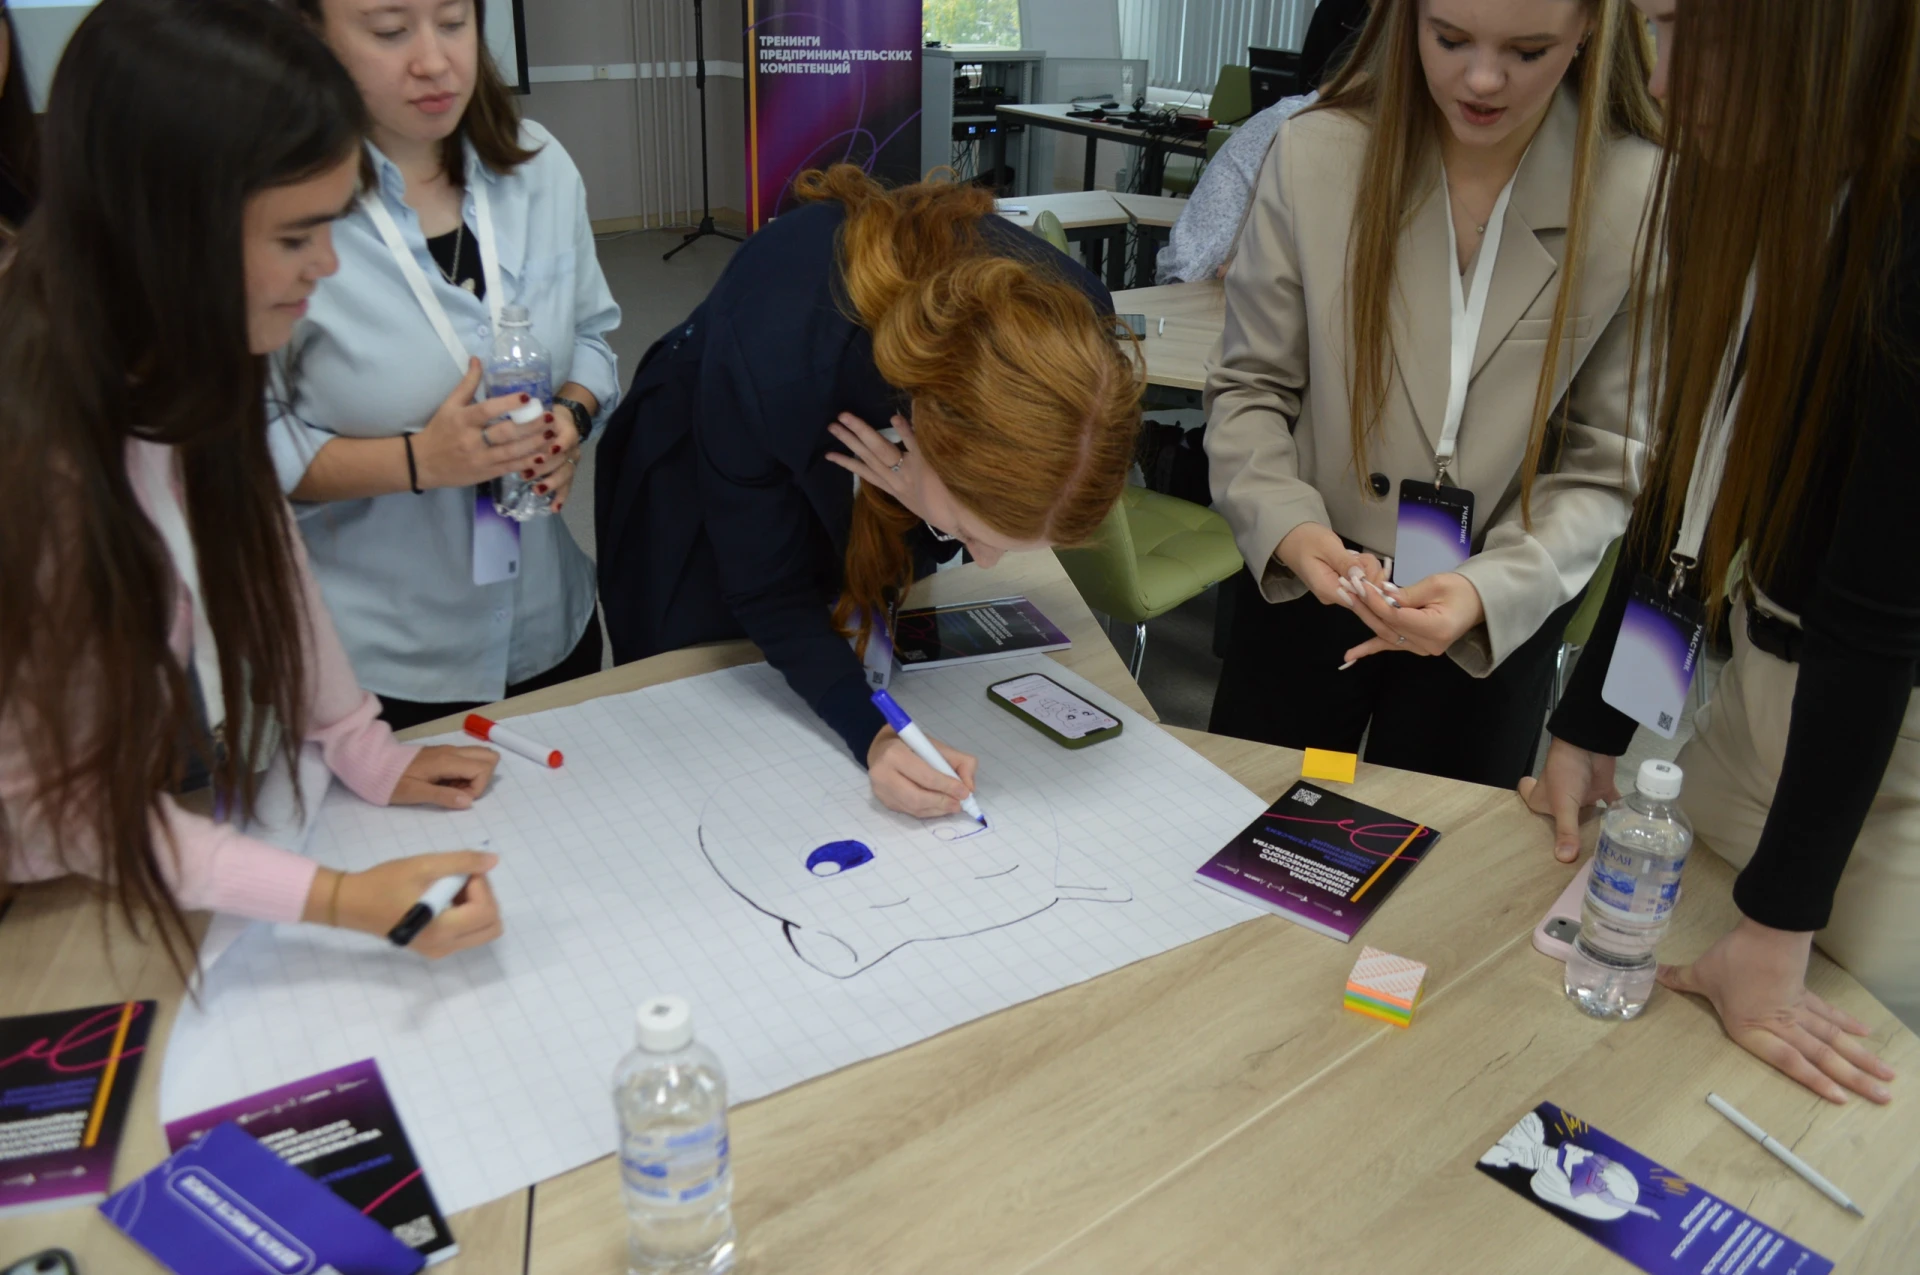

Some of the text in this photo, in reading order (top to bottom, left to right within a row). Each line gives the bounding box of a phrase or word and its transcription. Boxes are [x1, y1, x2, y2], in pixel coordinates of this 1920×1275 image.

[760, 36, 820, 47] ТРЕНИНГИ
[760, 49, 912, 62] ПРЕДПРИНИМАТЕЛЬСКИХ
[760, 61, 850, 75] КОМПЕТЕНЦИЙ
[1460, 505, 1469, 544] УЧАСТНИК
[1683, 624, 1703, 672] УЧАСТНИК
[1252, 837, 1359, 883] ПРЕДПРИНИМАТЕЛЬСТВА
[1259, 852, 1350, 892] УНИВЕРСИТЕТСКОГО
[1261, 848, 1355, 887] ТЕХНОЛОГИЧЕСКОГО
[1288, 870, 1346, 897] ПЛАТФОРМА
